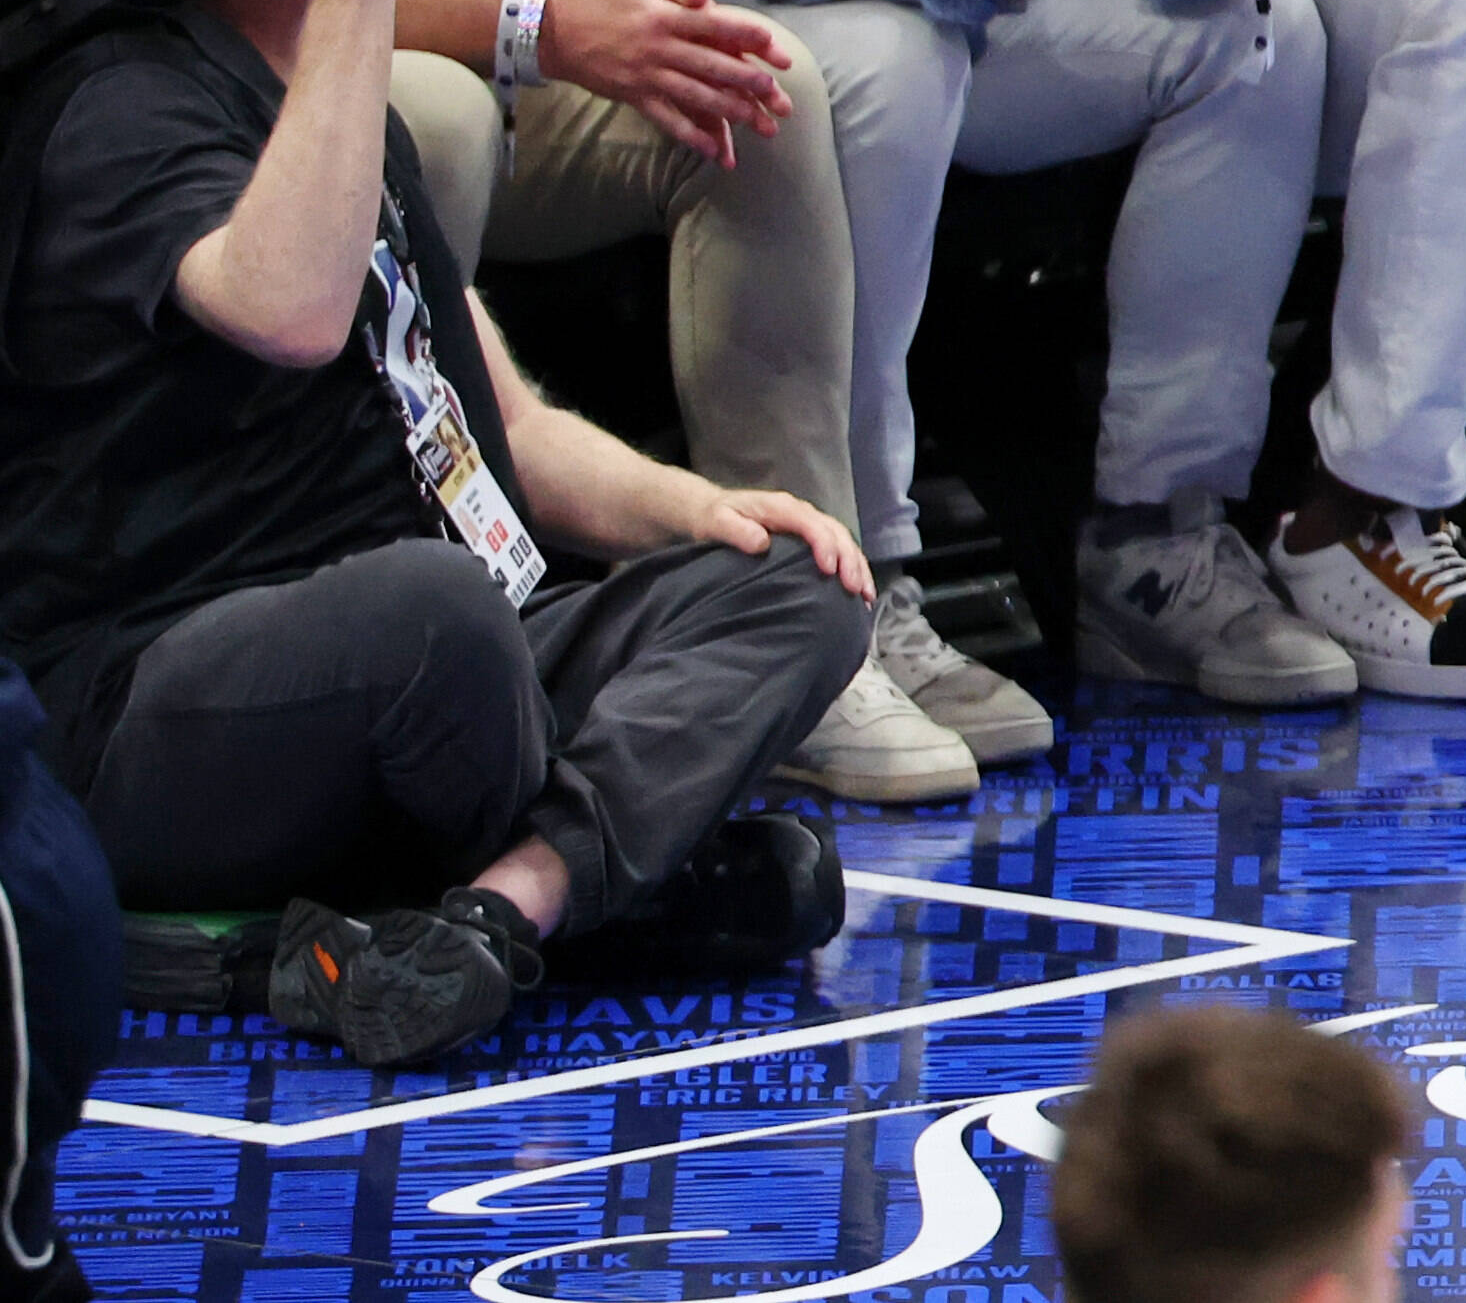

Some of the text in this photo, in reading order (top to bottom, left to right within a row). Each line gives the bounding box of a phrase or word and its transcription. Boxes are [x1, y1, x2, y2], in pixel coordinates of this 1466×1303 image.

[1180, 972, 1344, 990] DALLAS
[639, 1083, 889, 1106] ERIC RILEY
